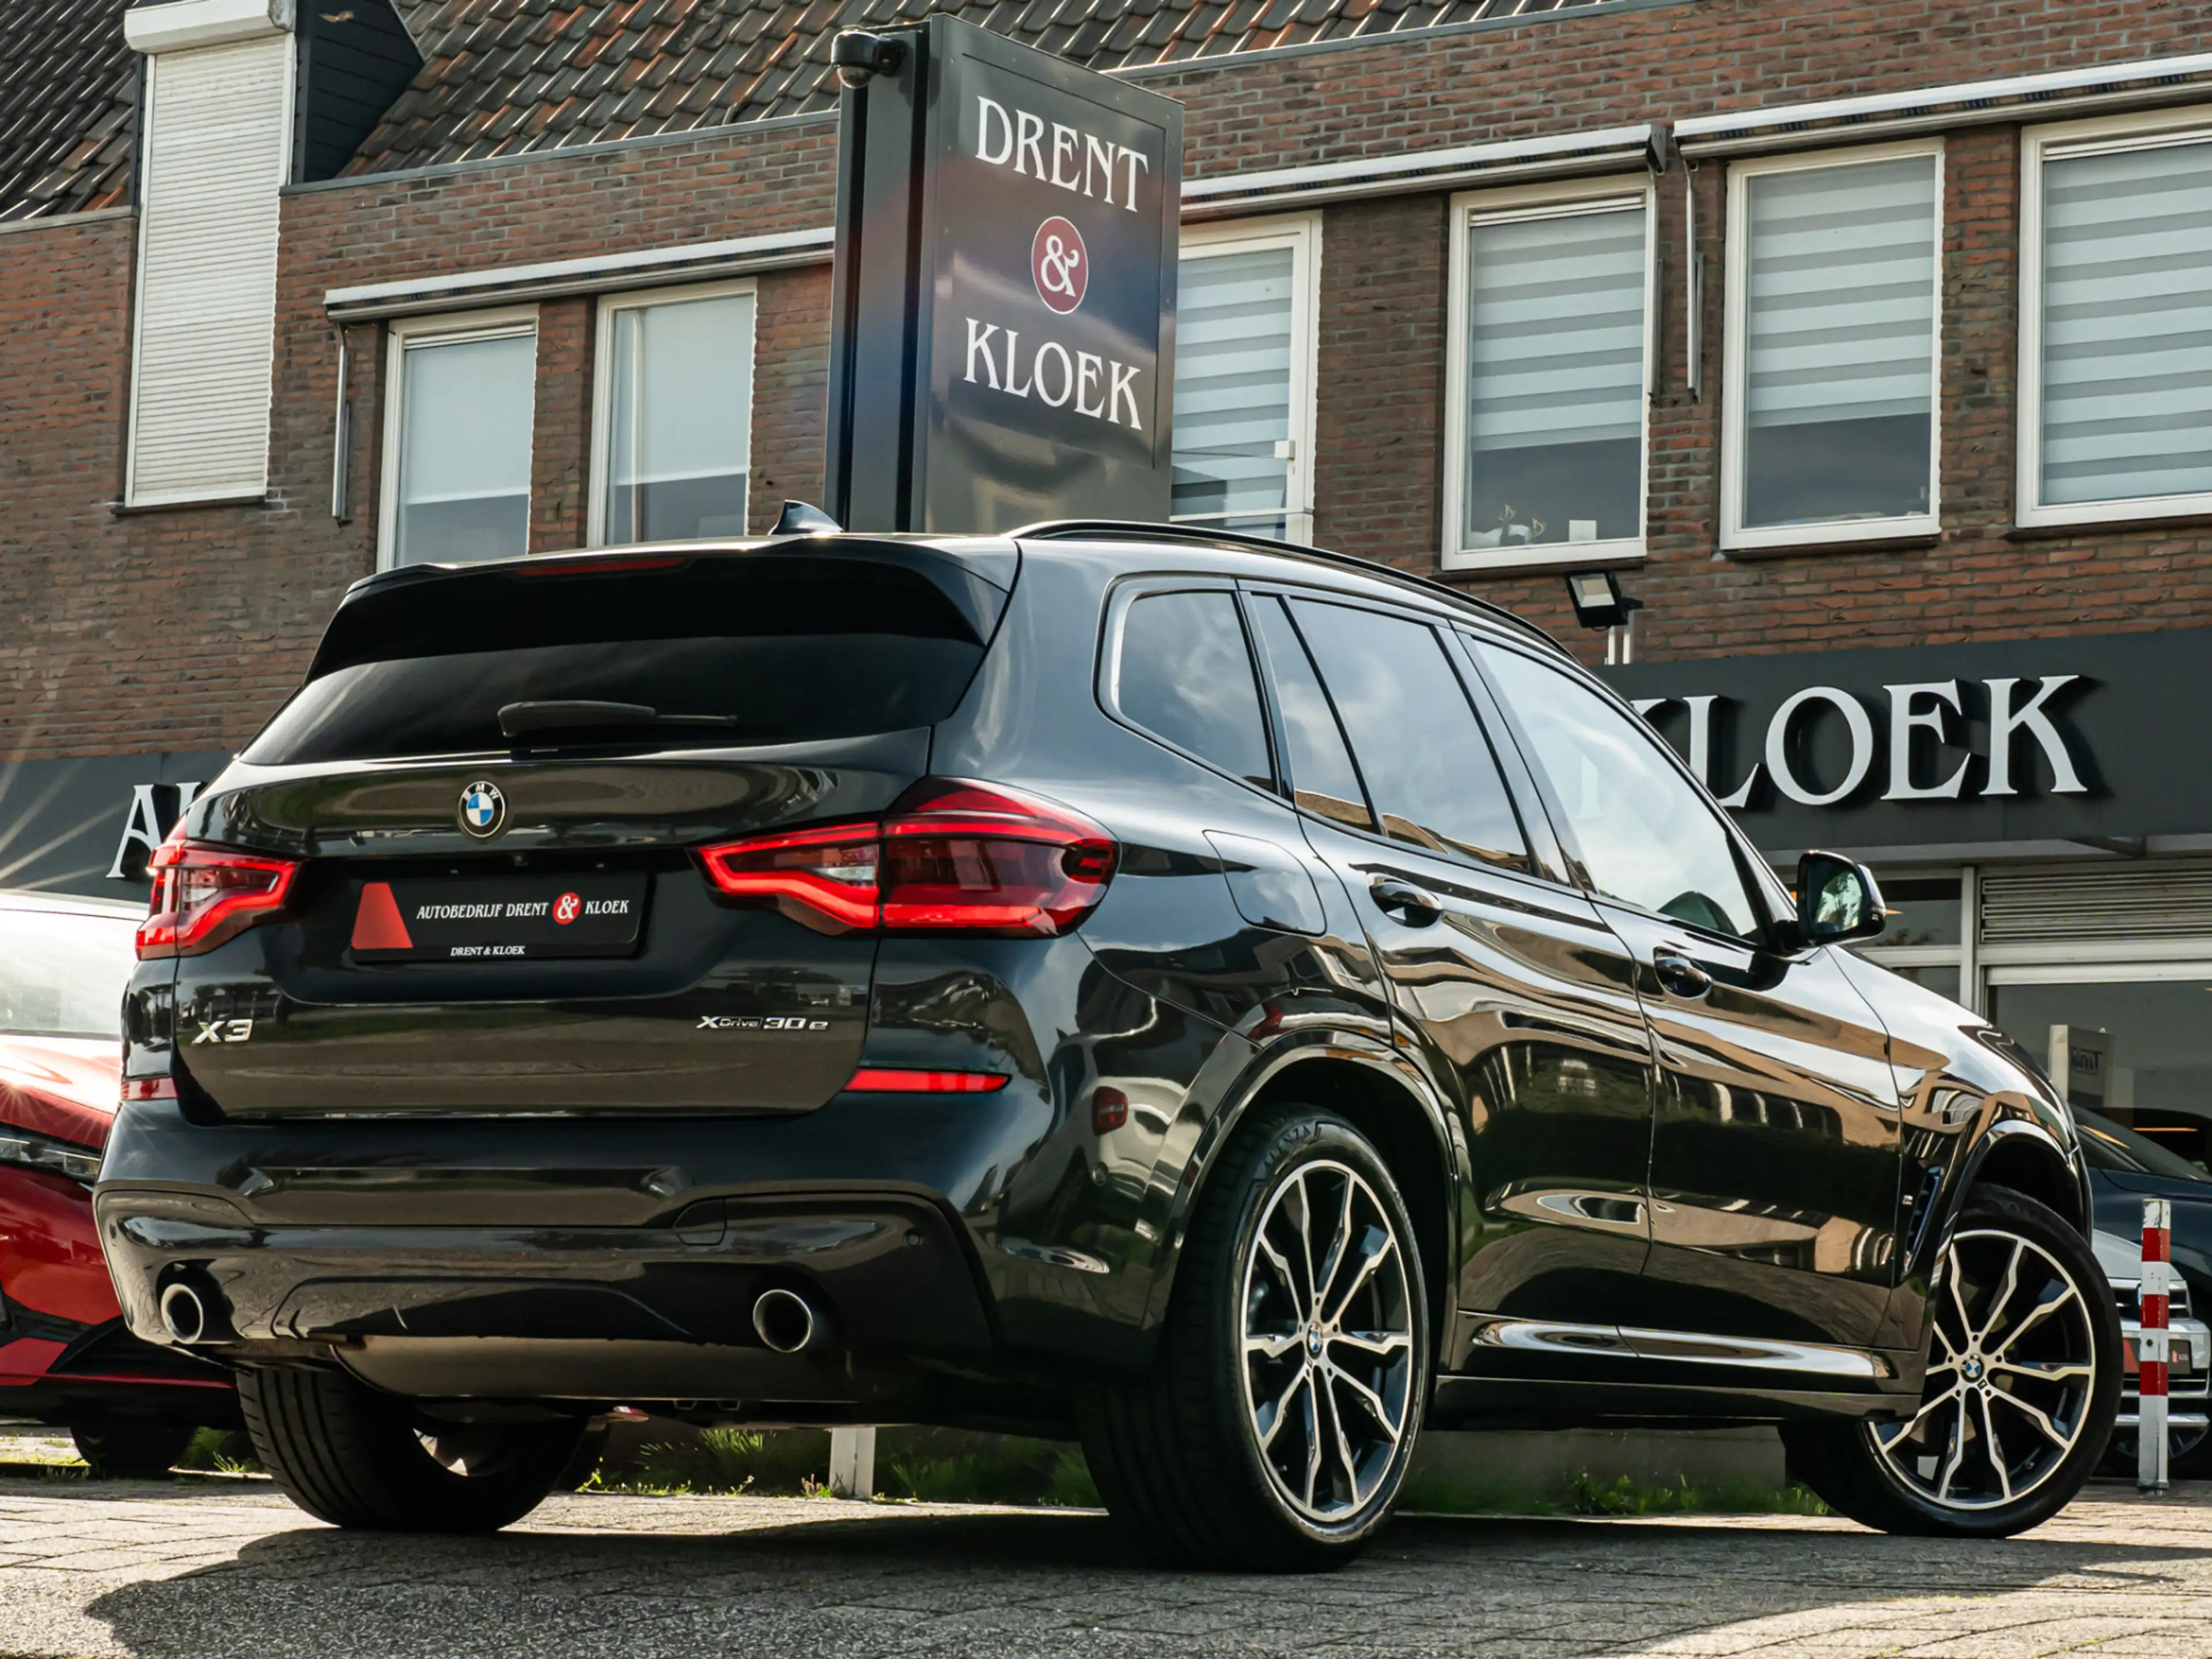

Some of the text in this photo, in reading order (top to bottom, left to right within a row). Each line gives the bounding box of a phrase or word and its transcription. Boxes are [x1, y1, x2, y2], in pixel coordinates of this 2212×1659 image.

[975, 96, 1149, 213] DRENT
[1040, 236, 1080, 298] &
[964, 317, 1143, 431] KLOEK
[463, 783, 500, 800] BMW
[416, 895, 630, 919] AUTOBEDRIJF DRENT & KLOEK
[450, 945, 525, 956] DRENT & KLOEK
[191, 1019, 253, 1044] X3
